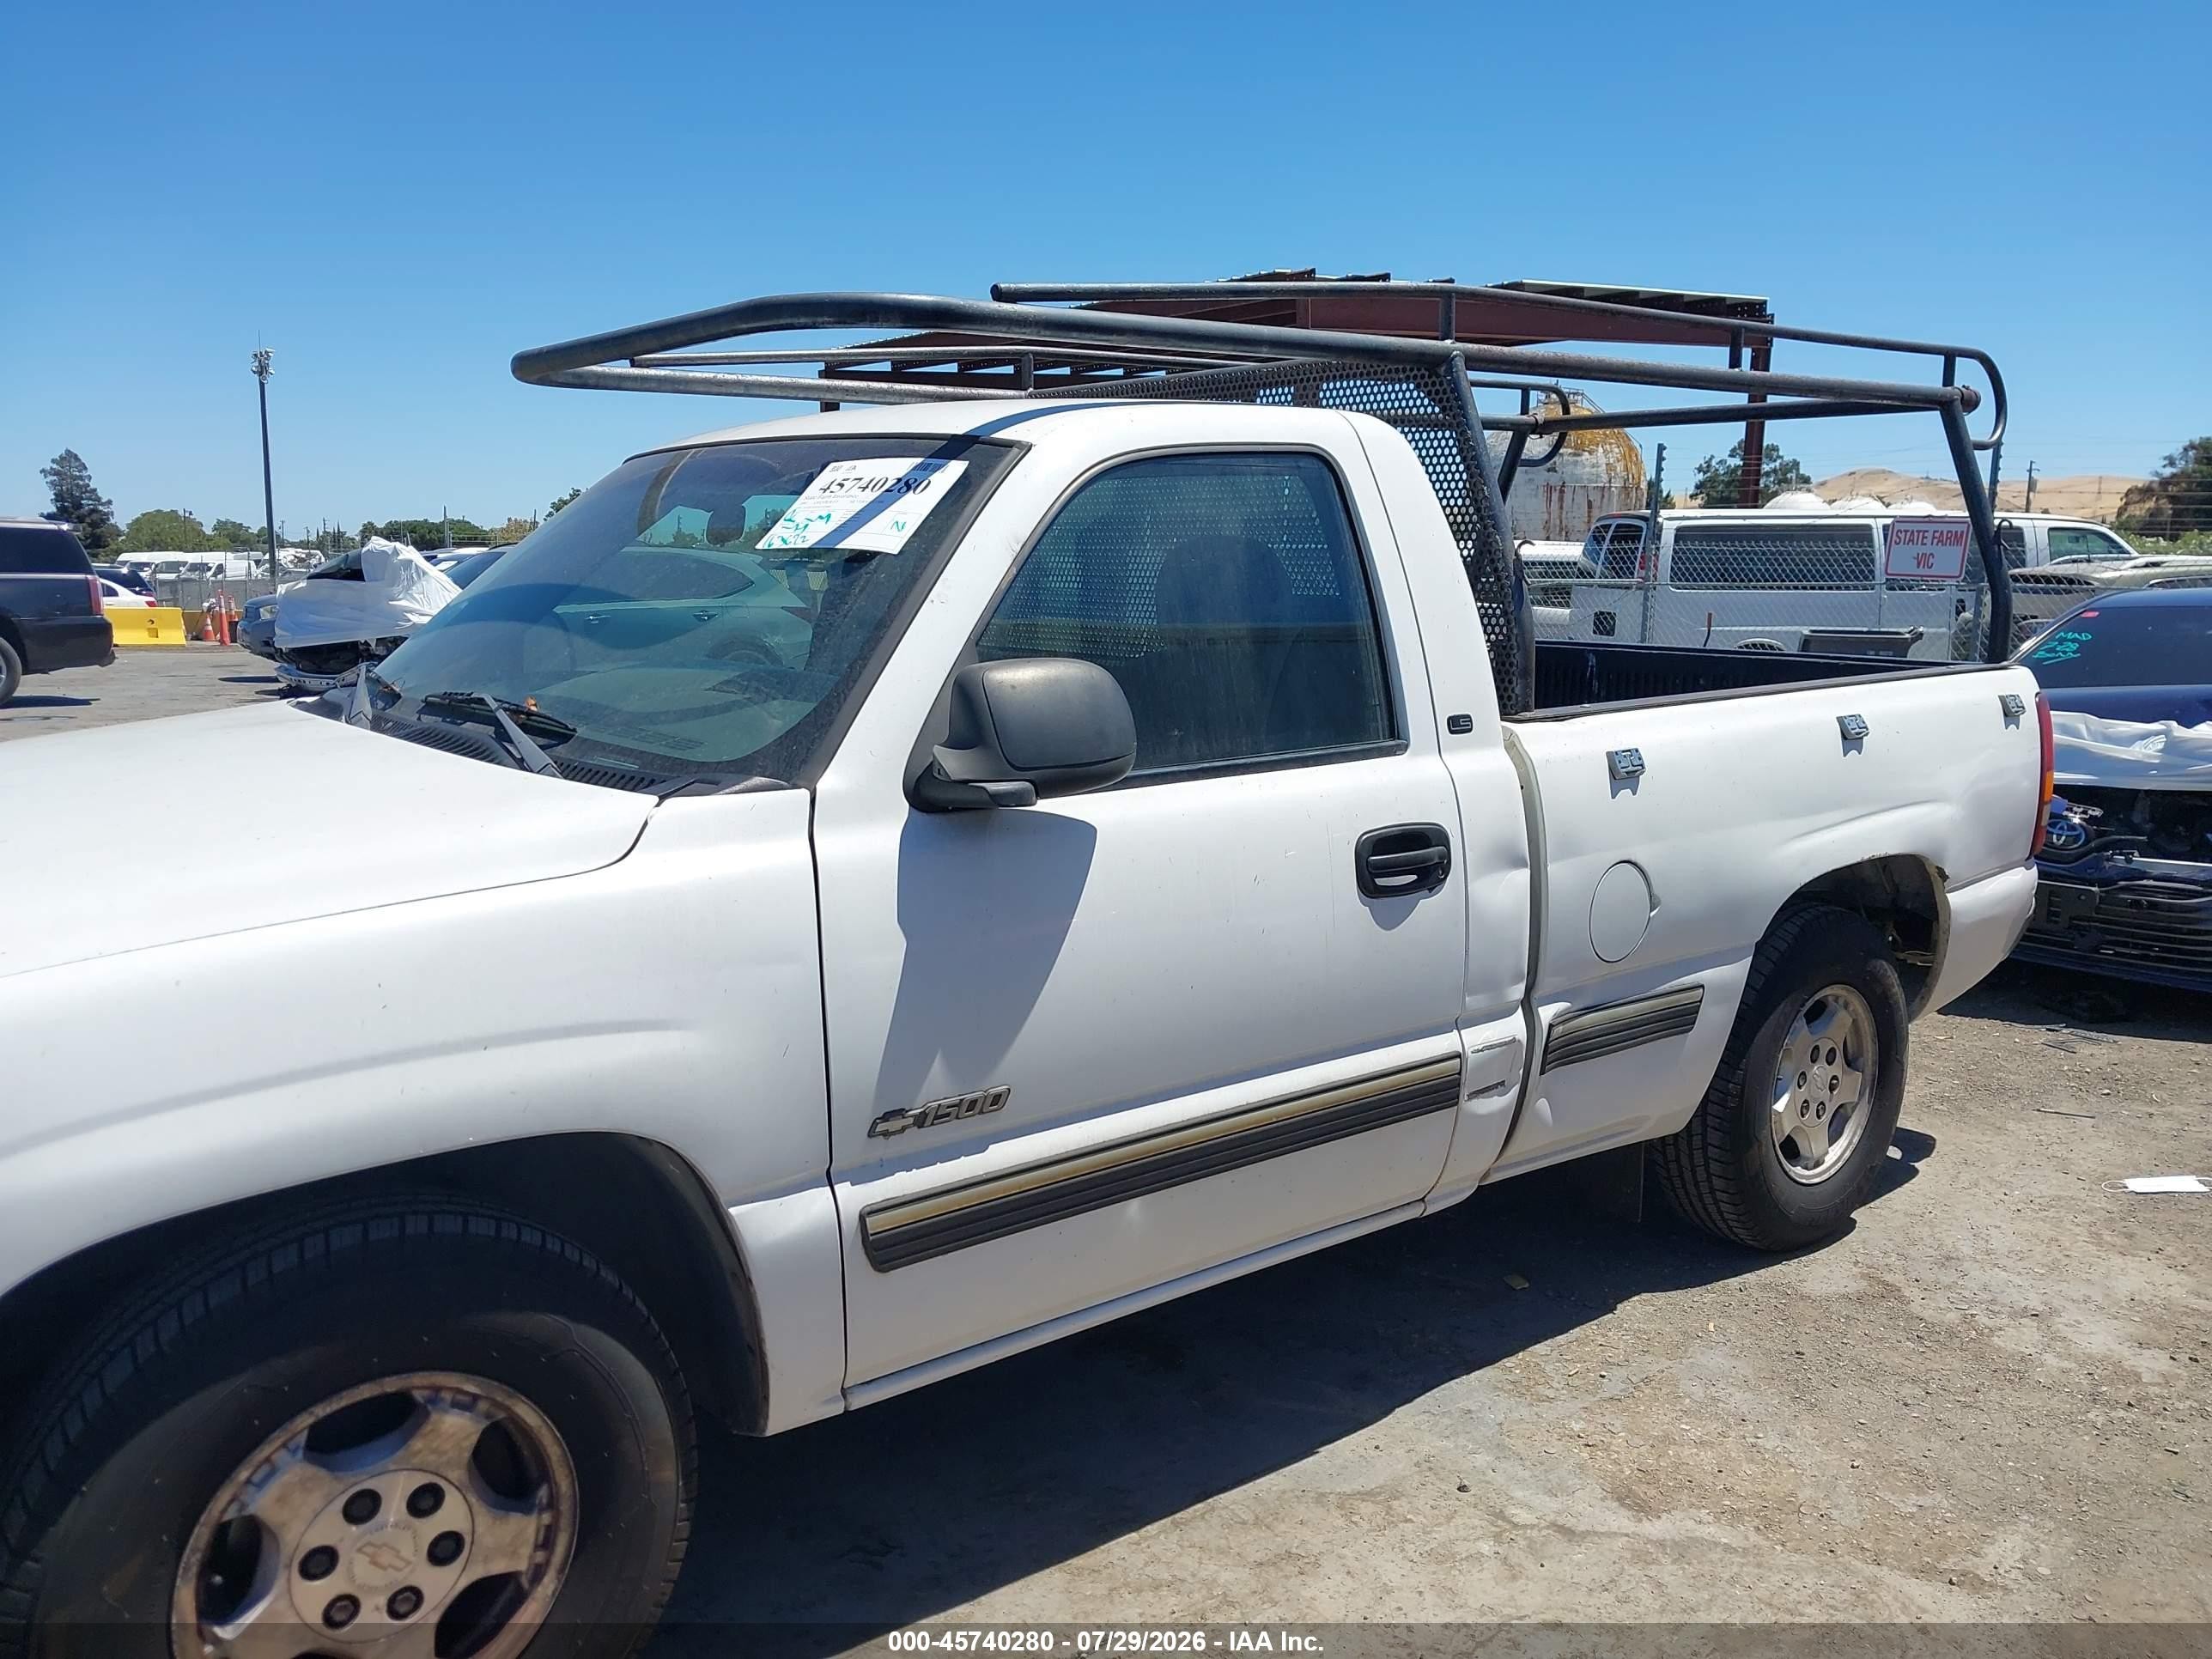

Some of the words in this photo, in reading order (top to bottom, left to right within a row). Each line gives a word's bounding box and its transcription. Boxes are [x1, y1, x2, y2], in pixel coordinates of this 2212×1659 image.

[818, 477, 932, 495] 45740280
[1894, 529, 1929, 546] STATE
[1930, 529, 1965, 547] FARM
[918, 1085, 1011, 1128] 1500
